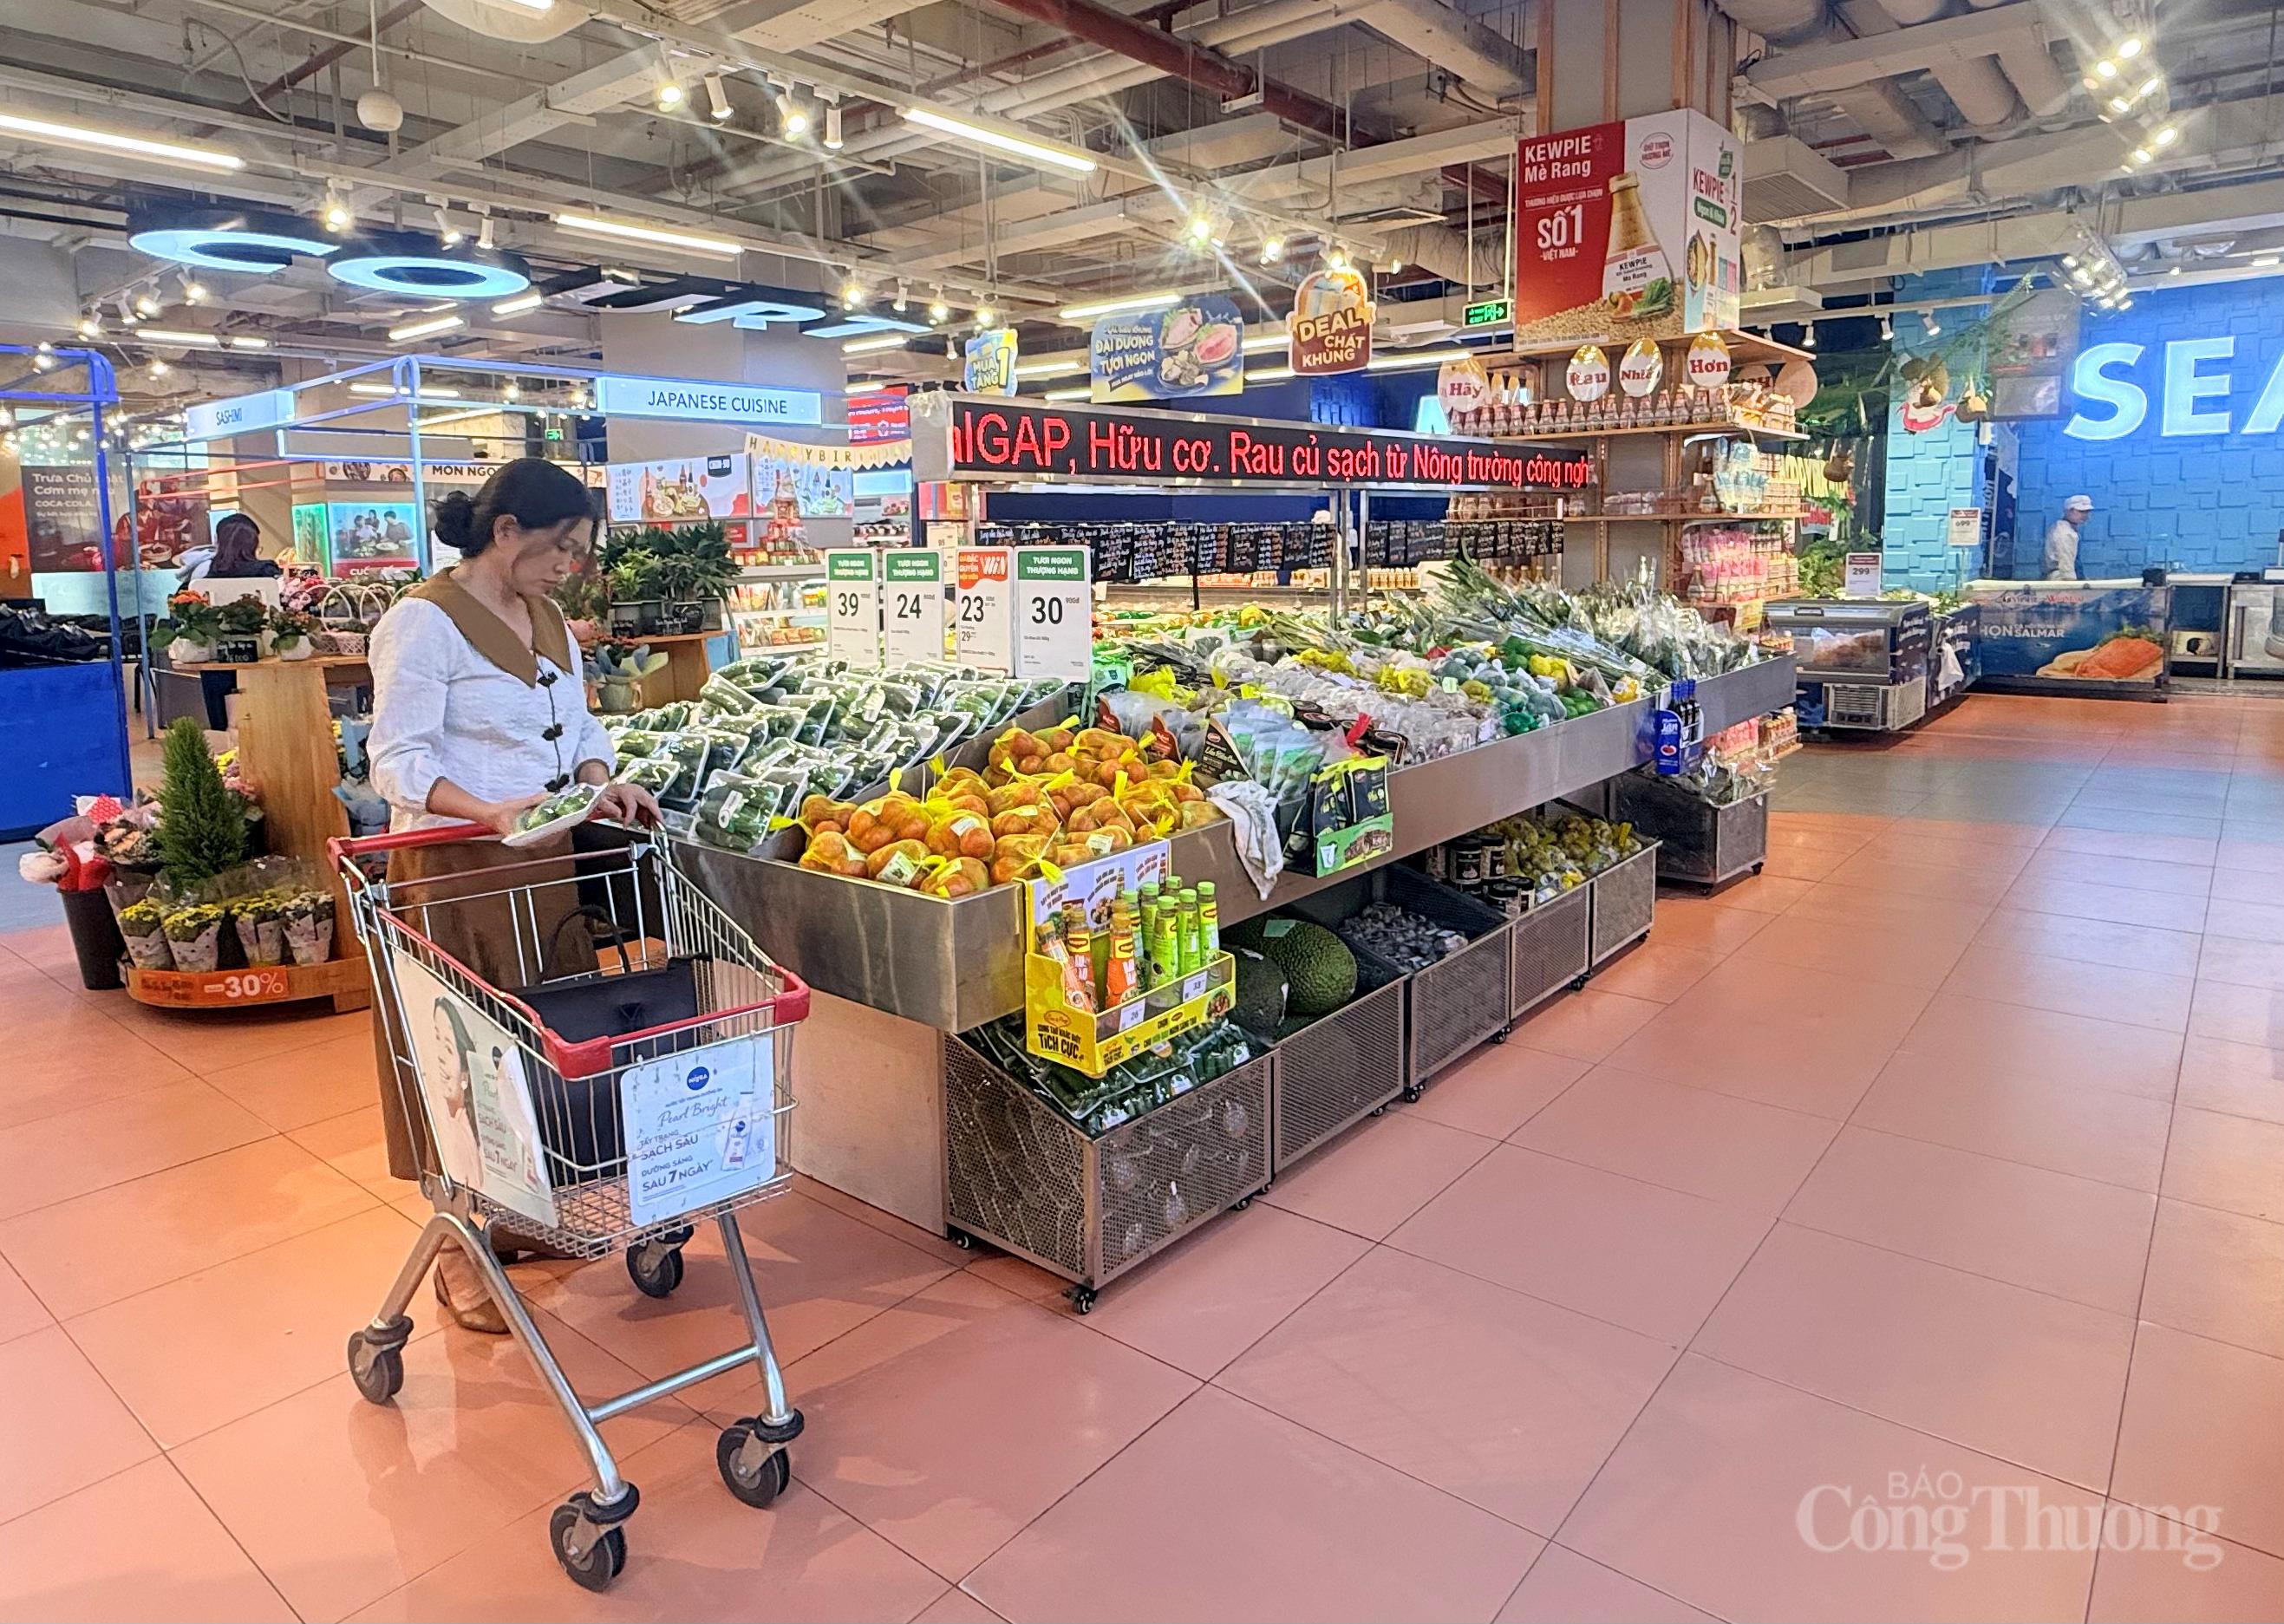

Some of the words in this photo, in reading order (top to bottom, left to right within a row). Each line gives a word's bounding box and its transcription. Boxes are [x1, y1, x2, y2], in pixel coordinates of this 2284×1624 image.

[1525, 135, 1591, 164] KEWPIE
[1524, 163, 1548, 184] Mè
[1551, 160, 1591, 179] Rang
[1693, 166, 1724, 204] KEWPIE
[1619, 257, 1648, 271] KEWPIE
[1299, 308, 1362, 343] DEAL
[972, 356, 996, 375] MUA
[995, 347, 1011, 388] 1
[1691, 359, 1729, 374] Hơn
[1569, 371, 1607, 387] Rau
[1450, 382, 1484, 399] Hãy
[648, 390, 728, 411] JAPANESE
[731, 396, 788, 414] CUISINE
[1089, 421, 1162, 471] Hữu
[1172, 437, 1220, 473] cơ.
[1230, 431, 1282, 475] Rau
[1292, 434, 1320, 476] củ
[1327, 440, 1381, 482] sạch
[1386, 443, 1409, 479] từ
[1413, 444, 1463, 485] Nông
[1468, 447, 1522, 487] trường
[1526, 453, 1563, 490] công
[32, 473, 63, 483] Trưa
[66, 473, 92, 483] Chủ
[467, 466, 499, 477] NGO
[34, 486, 65, 495] Cơm
[1852, 567, 1870, 576] 299
[838, 592, 858, 616] 39
[897, 593, 922, 619] 24
[961, 595, 984, 623] 23
[1031, 597, 1063, 624] 30
[961, 631, 971, 642] 29
[2014, 629, 2065, 638] SALMAR
[1060, 1038, 1080, 1060] CỰC
[688, 1073, 708, 1084] NIVEA
[657, 1106, 690, 1127] Pearl
[692, 1096, 730, 1117] Bright
[642, 1176, 667, 1192] SAU
[668, 1169, 679, 1184] 7
